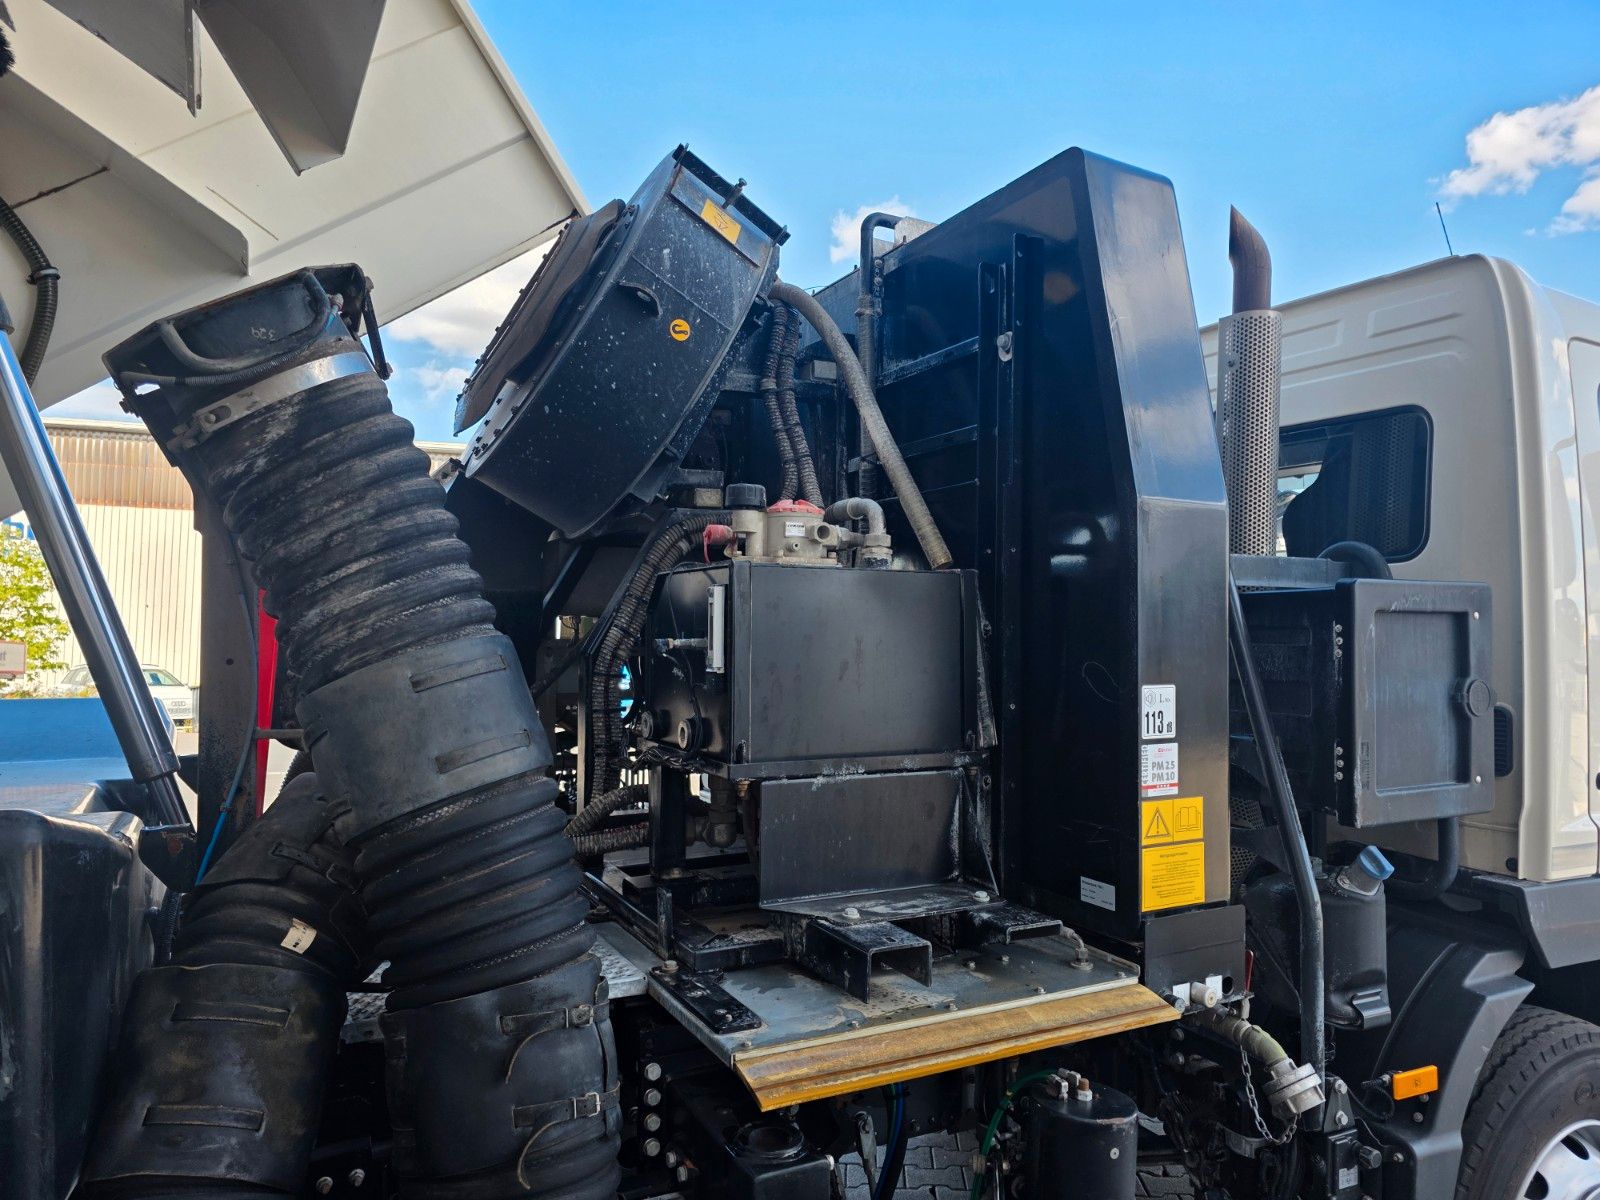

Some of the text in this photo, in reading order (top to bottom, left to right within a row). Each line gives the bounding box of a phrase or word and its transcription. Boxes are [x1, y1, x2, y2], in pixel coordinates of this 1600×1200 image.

[1145, 710, 1164, 734] 113
[1151, 761, 1164, 771] PM
[1151, 771, 1176, 782] PM 10
